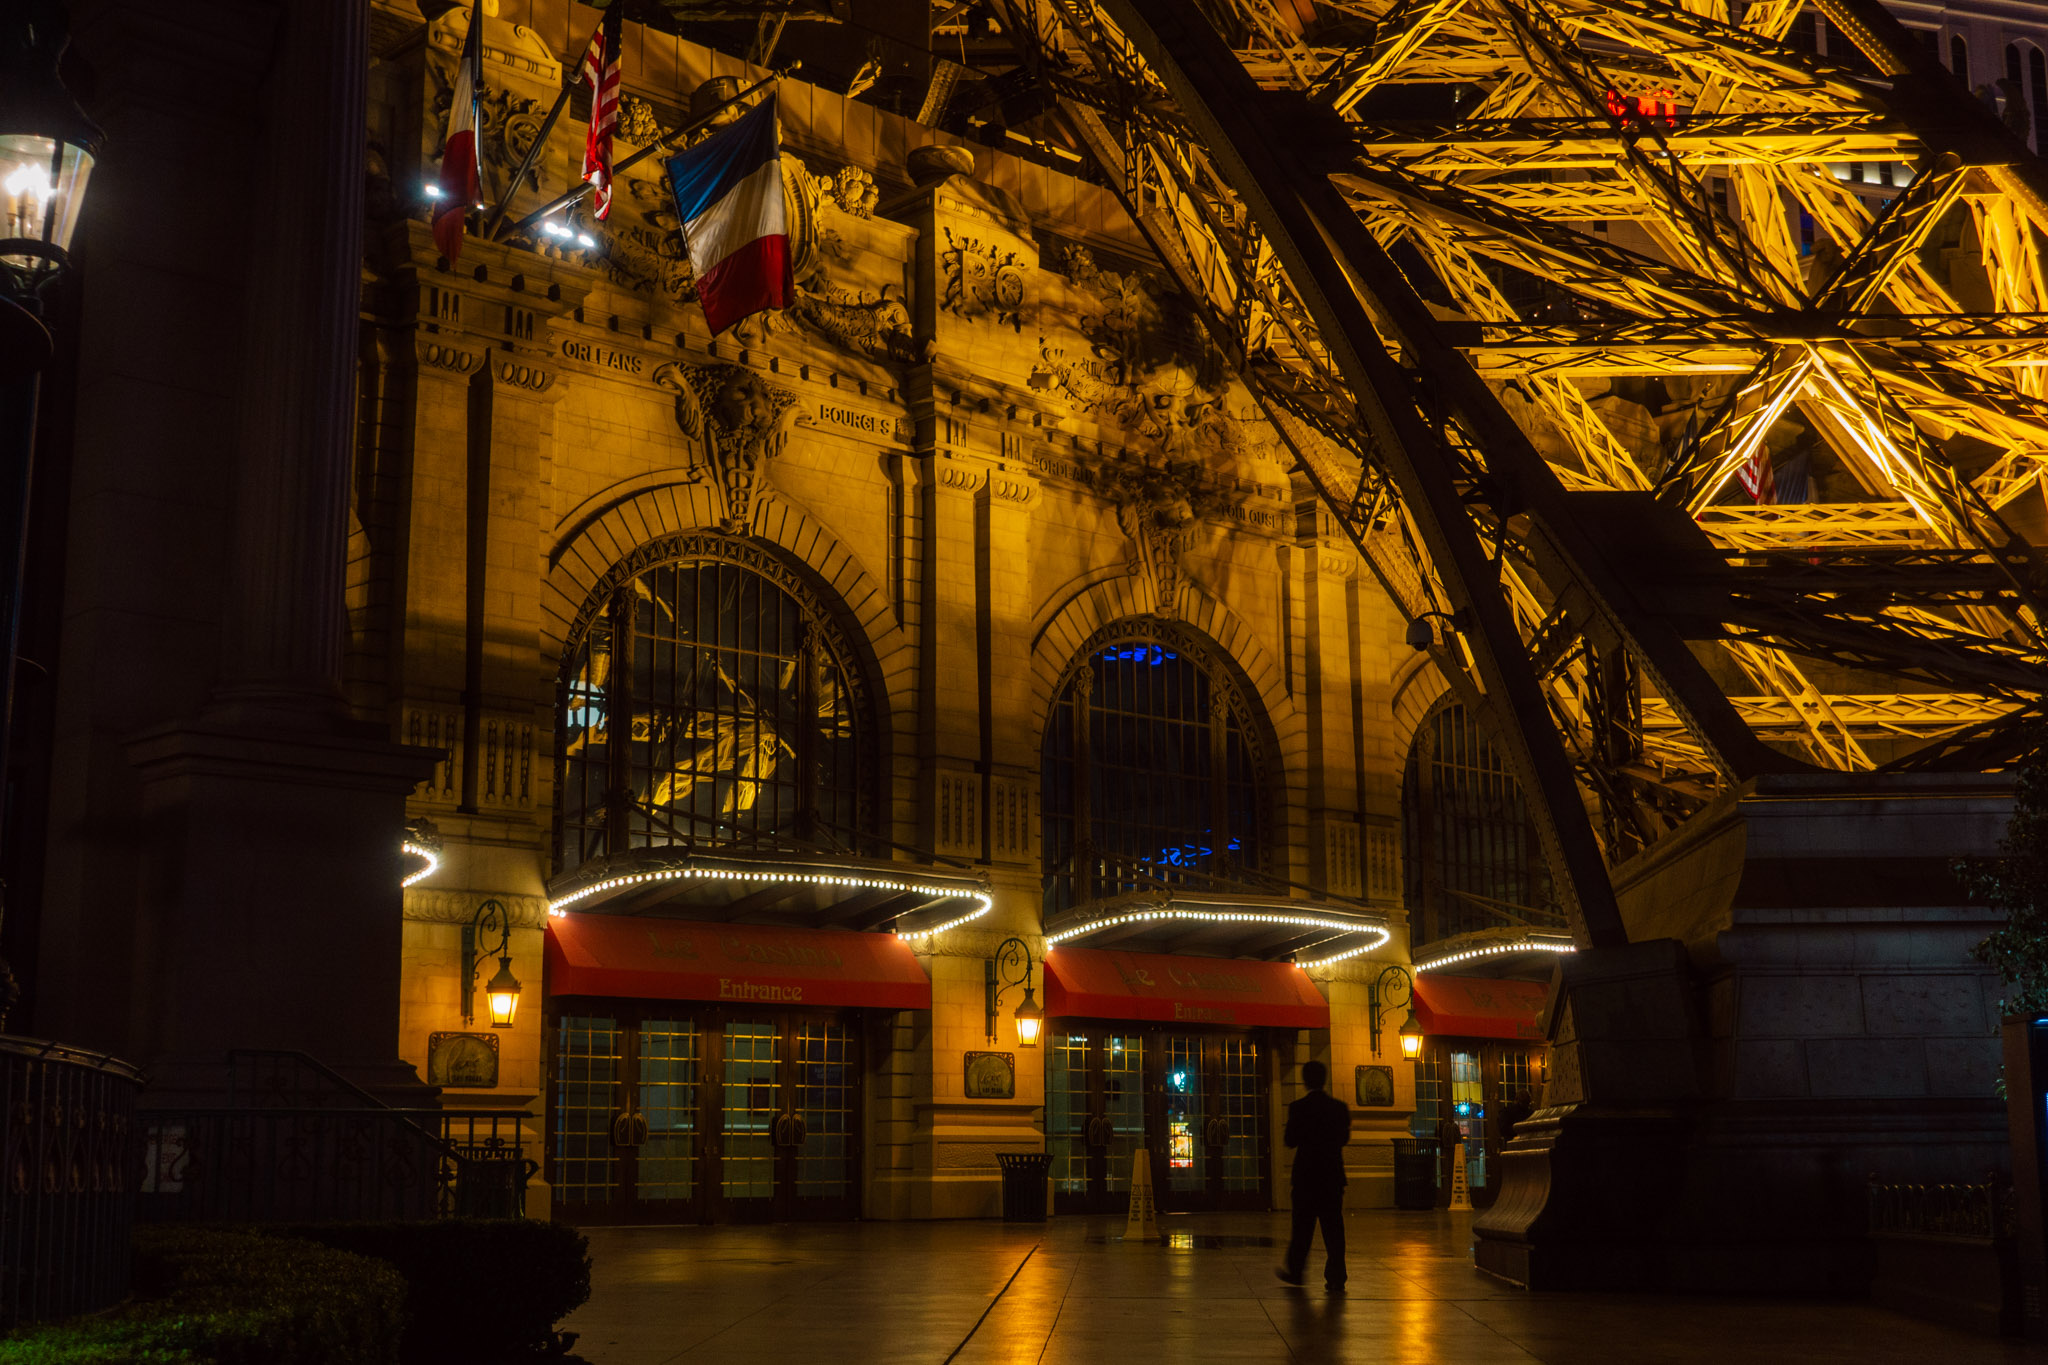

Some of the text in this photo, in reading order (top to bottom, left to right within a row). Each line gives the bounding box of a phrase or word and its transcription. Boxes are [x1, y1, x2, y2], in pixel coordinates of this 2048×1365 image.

[562, 339, 641, 375] ORLEANS
[820, 404, 889, 436] BOURGES
[719, 978, 802, 1001] Entrance
